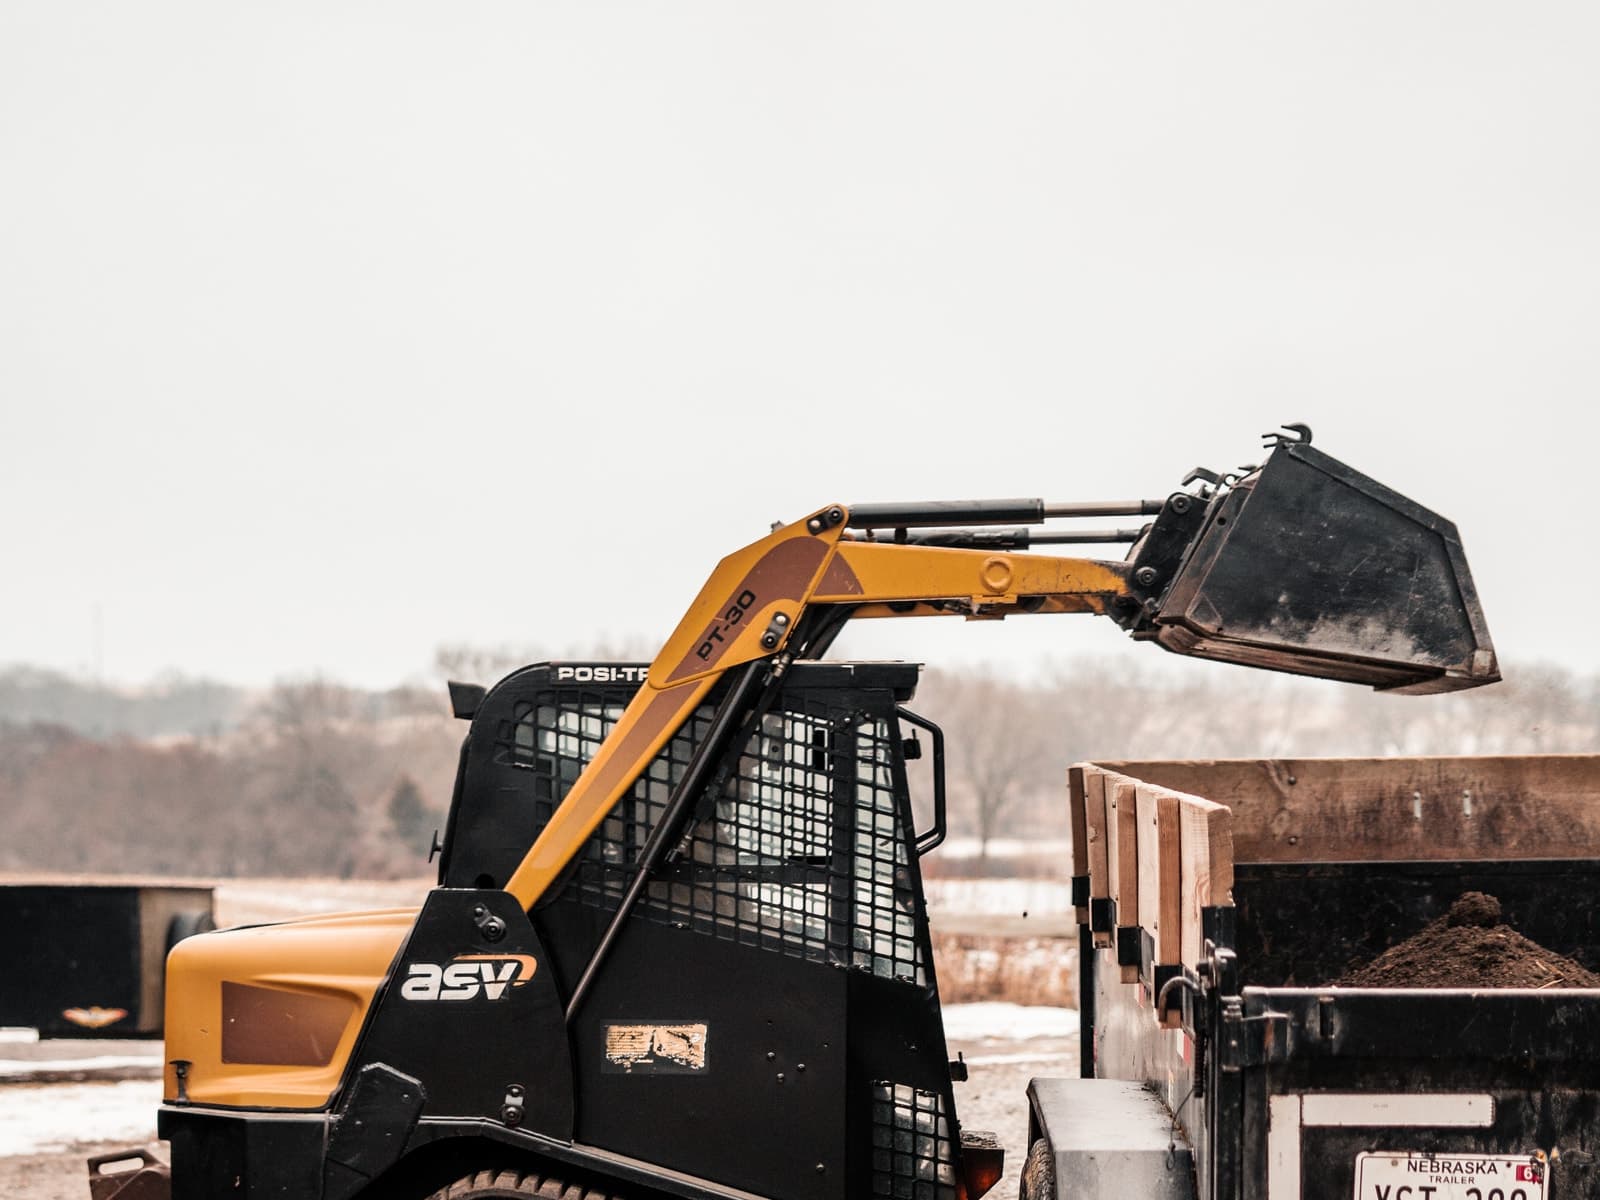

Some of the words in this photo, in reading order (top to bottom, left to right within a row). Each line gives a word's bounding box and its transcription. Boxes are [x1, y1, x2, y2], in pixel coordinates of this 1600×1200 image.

[696, 589, 757, 662] PT-30
[1407, 1160, 1498, 1175] NEBRASKA
[1429, 1175, 1475, 1185] TRAILER
